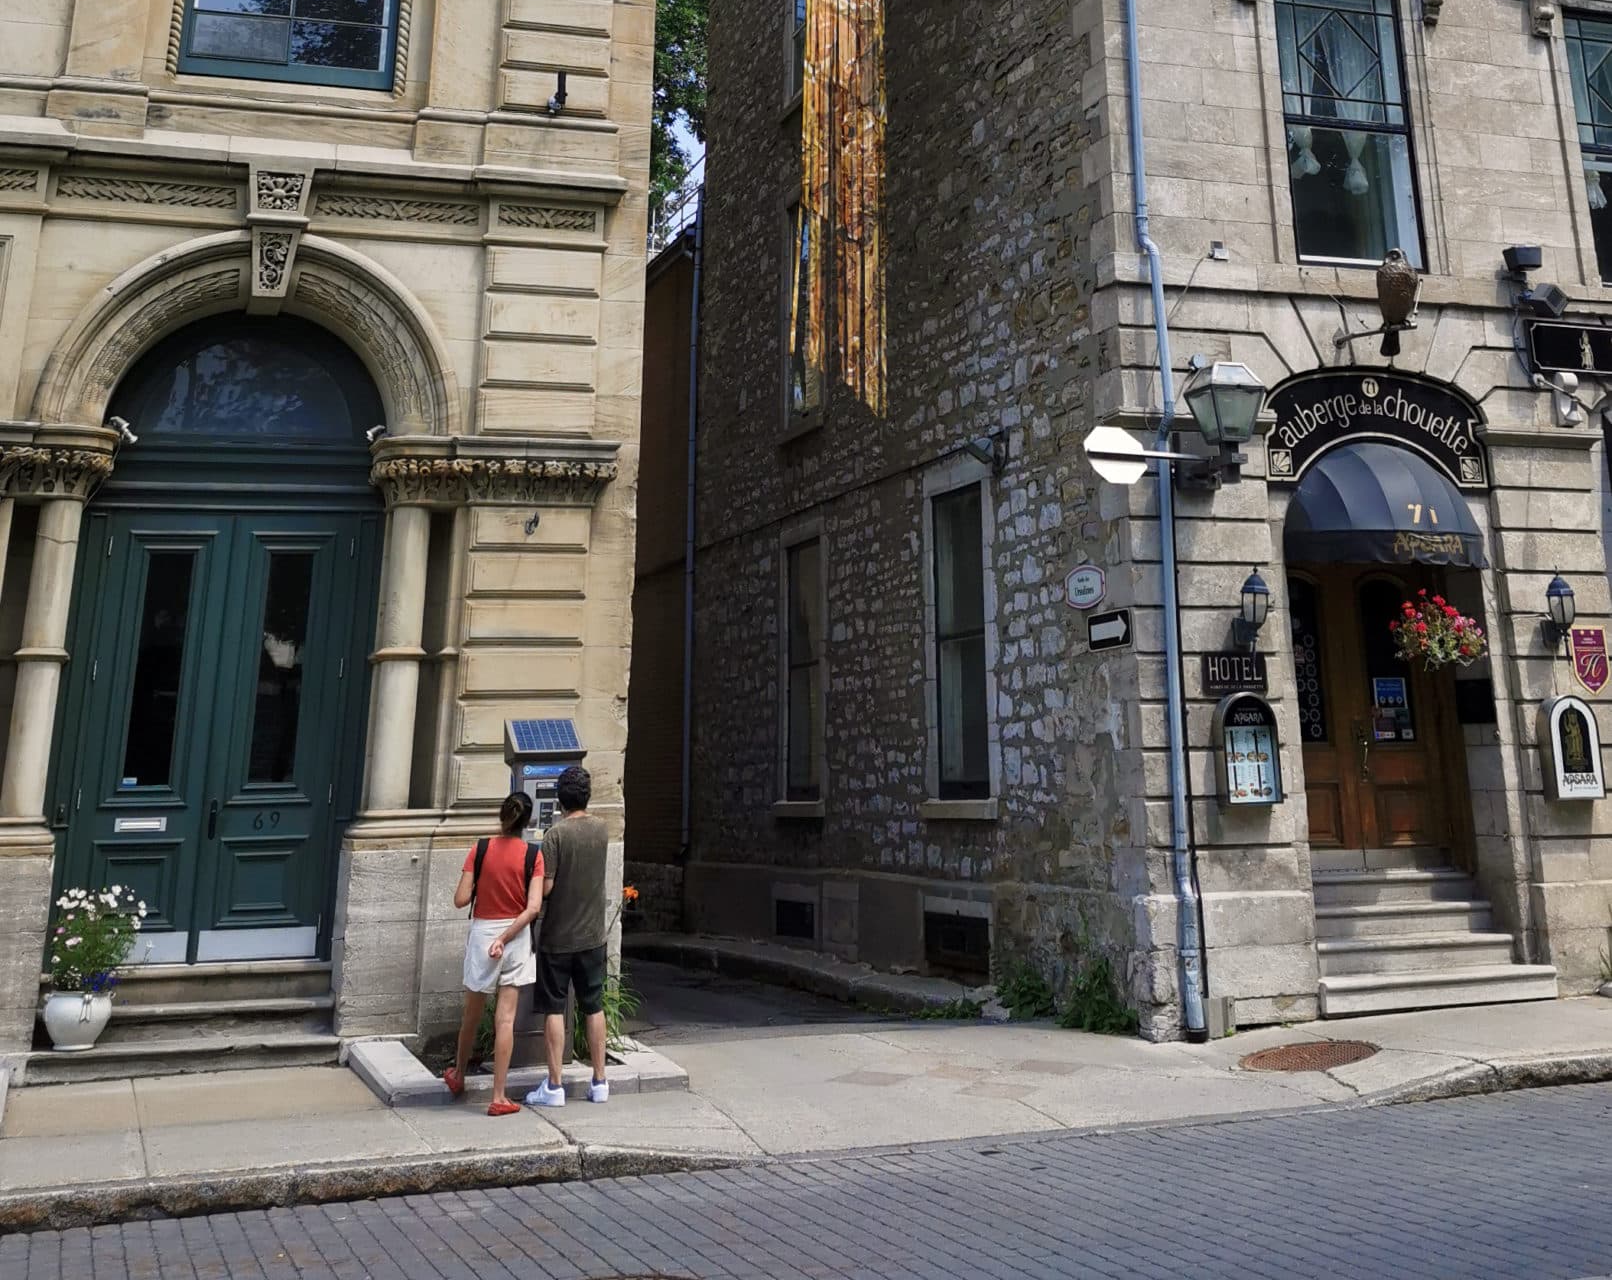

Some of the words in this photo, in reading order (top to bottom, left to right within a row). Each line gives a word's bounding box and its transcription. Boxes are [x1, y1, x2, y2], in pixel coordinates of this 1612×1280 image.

[1364, 380, 1377, 395] 71
[1279, 394, 1357, 448] auberge
[1358, 400, 1372, 415] de
[1373, 400, 1384, 416] la
[1383, 388, 1469, 456] chouette
[1407, 504, 1438, 524] 71
[1208, 656, 1263, 681] HOTEL
[253, 811, 280, 830] 69
